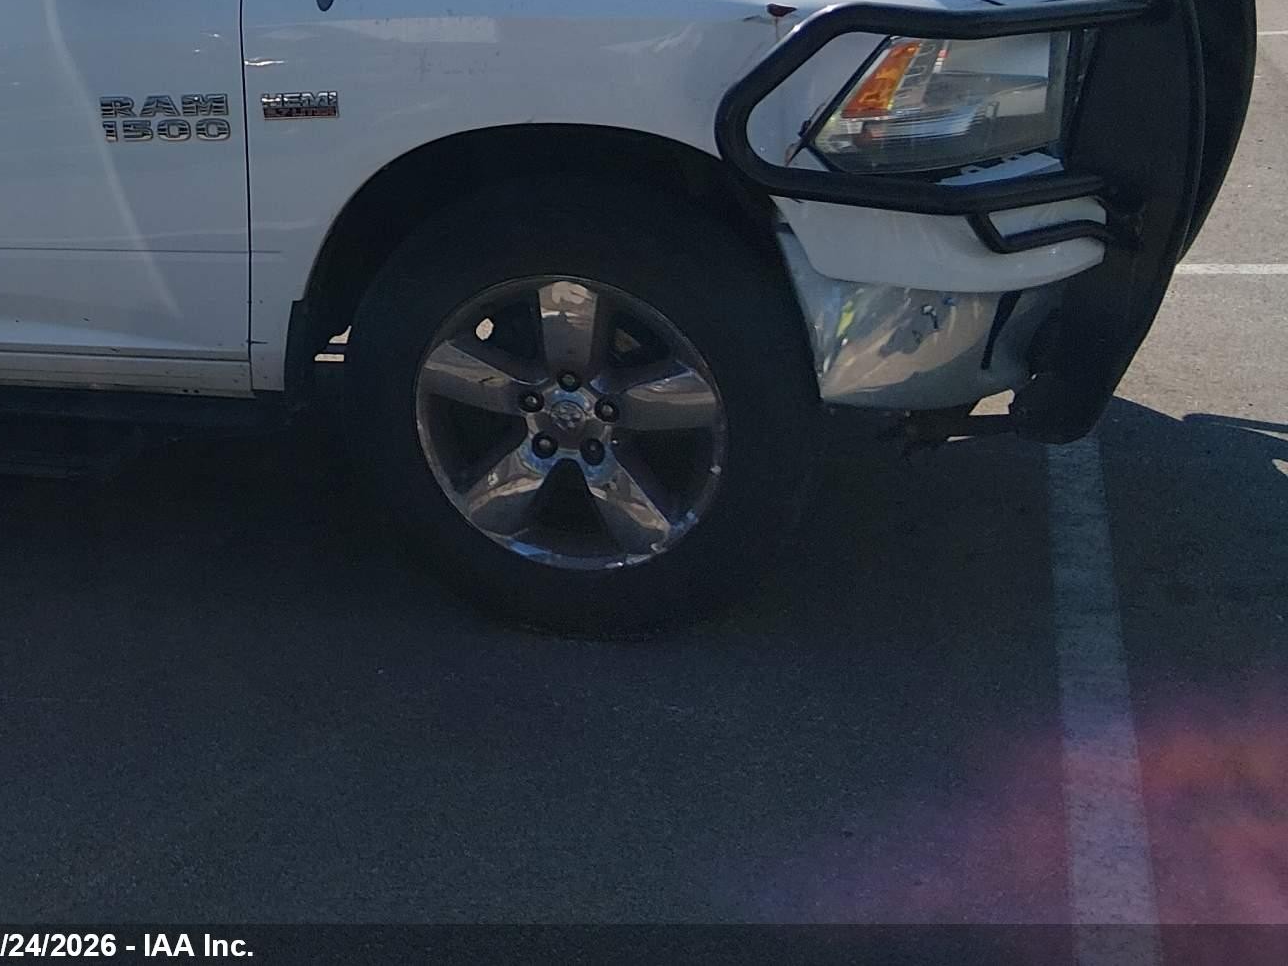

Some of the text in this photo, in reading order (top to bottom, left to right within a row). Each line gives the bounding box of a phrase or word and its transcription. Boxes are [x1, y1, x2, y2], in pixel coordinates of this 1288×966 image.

[100, 94, 229, 118] RAM
[261, 91, 337, 107] HEMI
[102, 118, 231, 142] 1500
